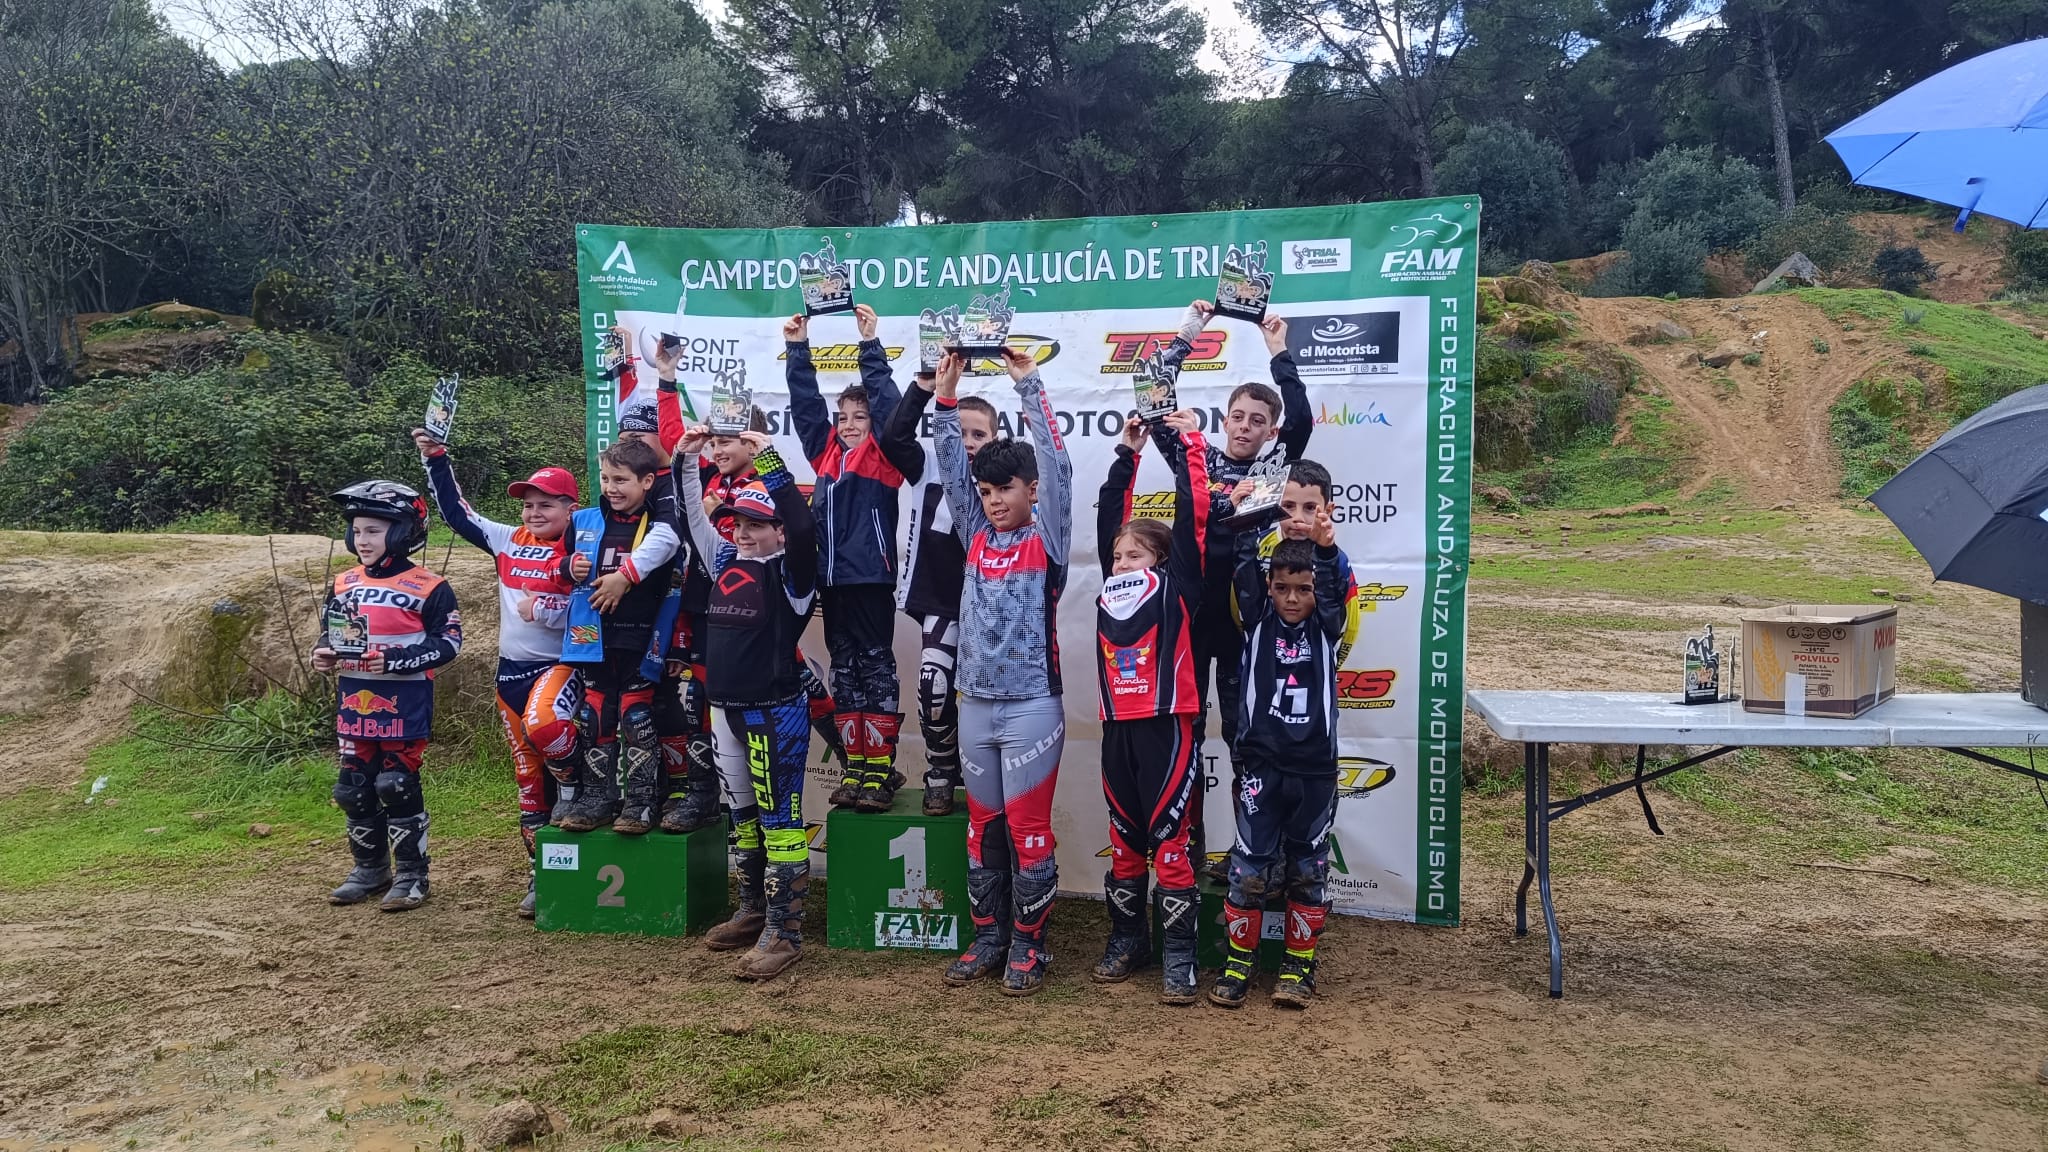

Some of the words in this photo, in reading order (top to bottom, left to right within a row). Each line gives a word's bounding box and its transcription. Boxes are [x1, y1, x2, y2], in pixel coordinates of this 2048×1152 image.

[680, 257, 887, 291] CAMPEOTO
[893, 256, 931, 289] DE
[936, 241, 1117, 289] ANDALUCÍA
[1124, 247, 1163, 281] DE
[1380, 247, 1464, 273] FAM
[606, 274, 616, 282] de
[616, 274, 658, 288] Andalucía
[679, 337, 739, 356] PONT
[1299, 345, 1312, 358] el
[1314, 343, 1380, 357] Motorista
[818, 362, 860, 370] DUNLO
[1437, 297, 1458, 484] FEDERACION
[1312, 401, 1393, 428] dalucía
[1330, 483, 1398, 503] PONT
[1330, 505, 1397, 524] GRUP
[1432, 492, 1455, 641] ANDALUZA
[1104, 578, 1144, 594] hebo
[709, 603, 758, 617] hebo
[1793, 654, 1840, 664] POLVILLO
[1430, 651, 1448, 688] DE
[1336, 668, 1397, 699] RS
[1337, 700, 1395, 709] SPENSION
[336, 714, 361, 736] Red
[363, 718, 404, 738] Bull
[1003, 720, 1065, 773] hebo
[805, 766, 827, 775] unta
[1427, 698, 1448, 911] MOTOCICLISMO
[547, 856, 574, 865] FAM
[887, 826, 944, 910] 1
[596, 864, 626, 907] 2
[1328, 876, 1378, 889] Andalucía
[1337, 888, 1364, 897] Turismo,
[879, 913, 955, 937] FAM
[1267, 925, 1285, 935] FA
